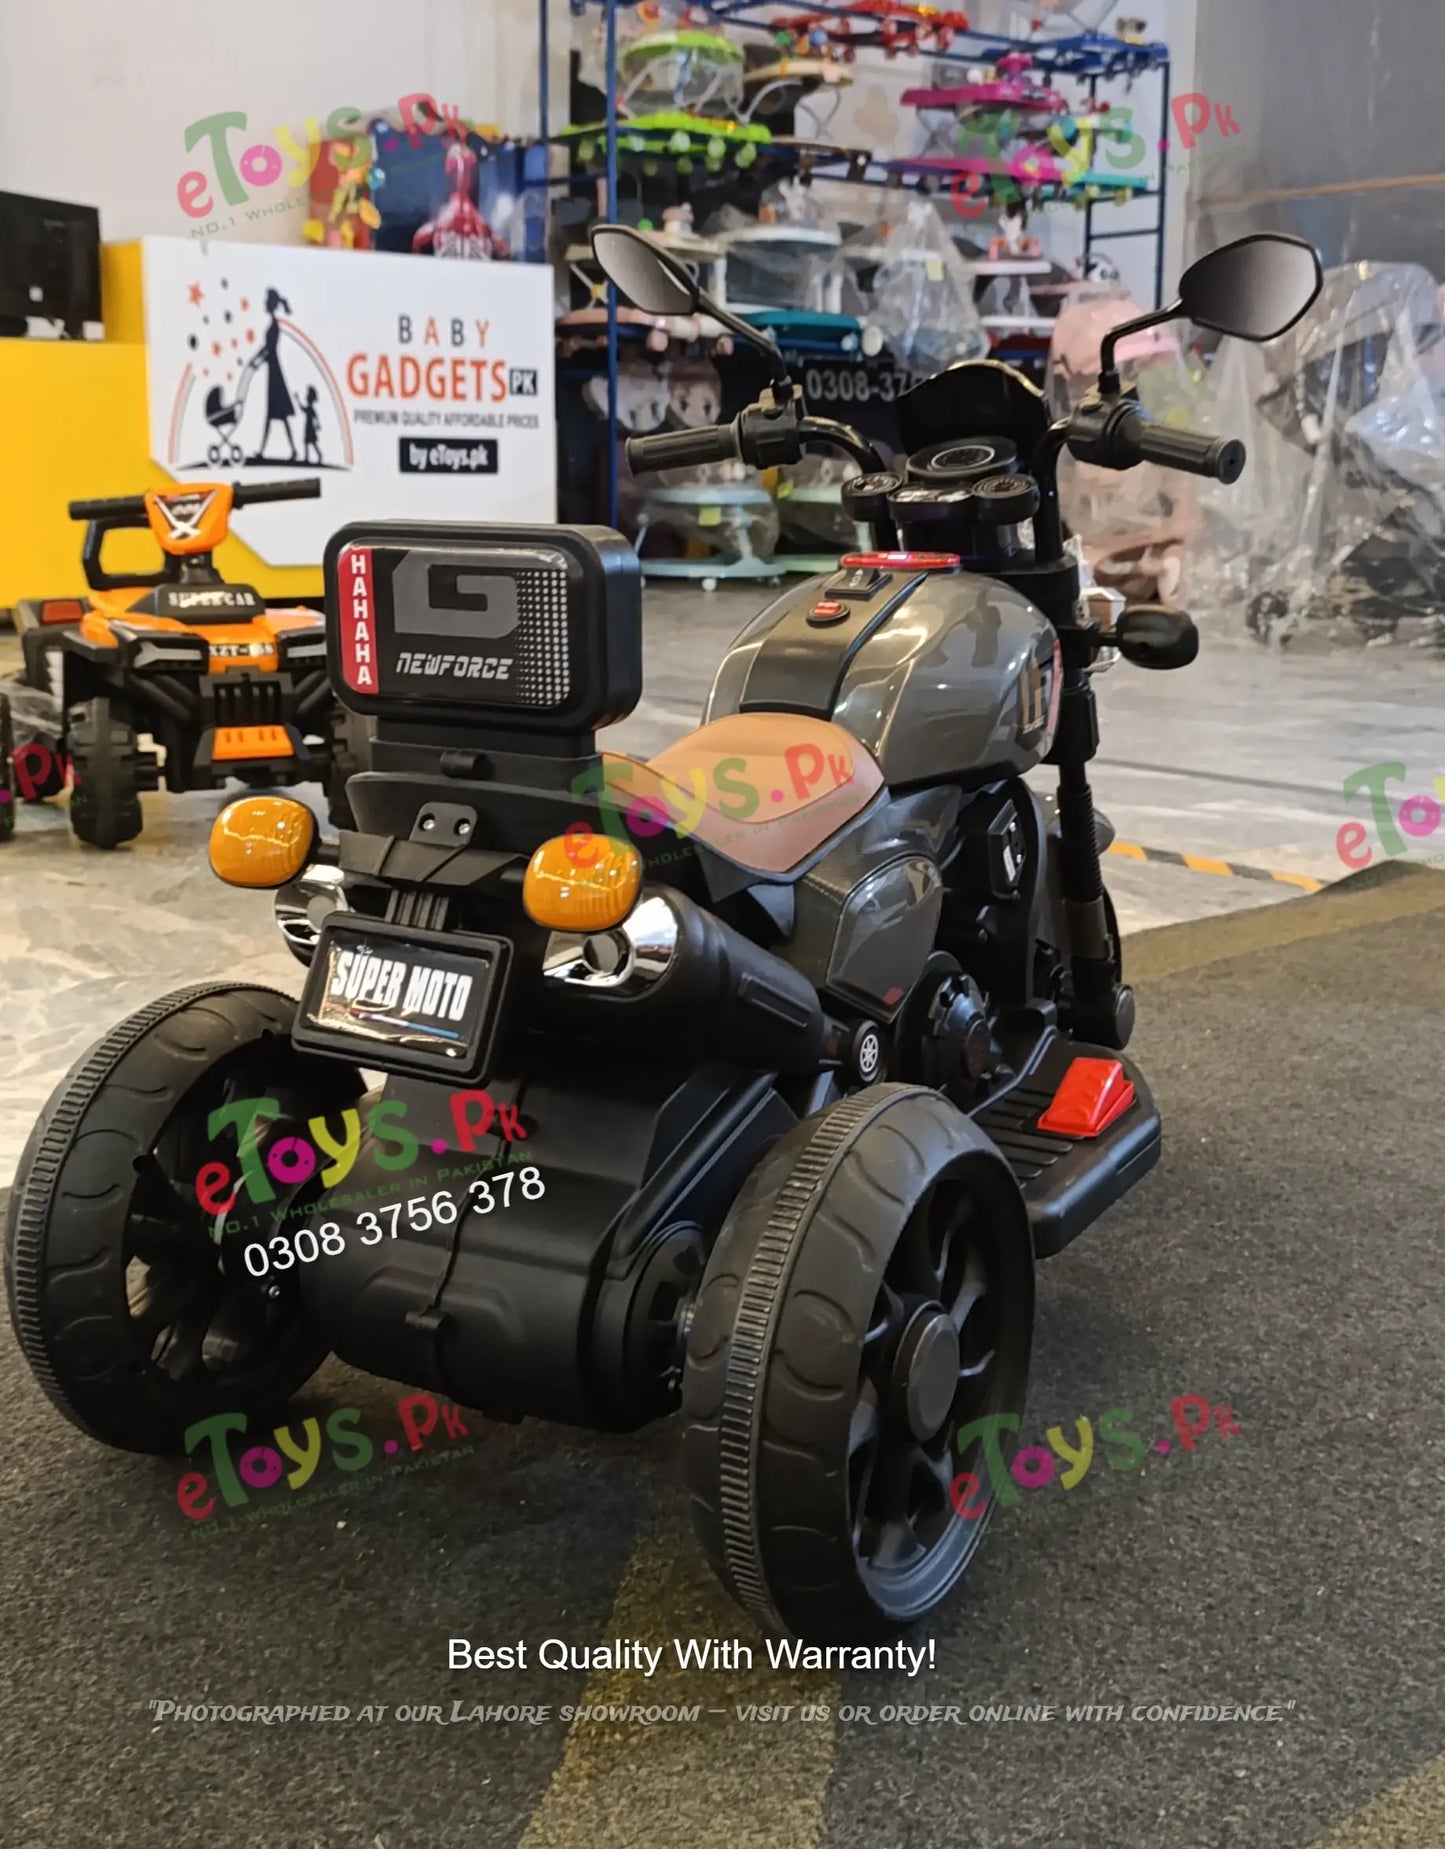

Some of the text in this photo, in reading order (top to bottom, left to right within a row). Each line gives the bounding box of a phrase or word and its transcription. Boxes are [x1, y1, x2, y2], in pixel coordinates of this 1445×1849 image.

[398, 314, 490, 348] BABY
[346, 353, 537, 403] GADGETS PK
[353, 409, 540, 429] PREMIUM QUALITY AFFORDABLE PRICES
[408, 443, 489, 471] by eToys.pk
[351, 555, 372, 685] HAHAHA
[395, 652, 513, 680] NEWFORCE
[330, 950, 473, 1021] SUPER MOTO
